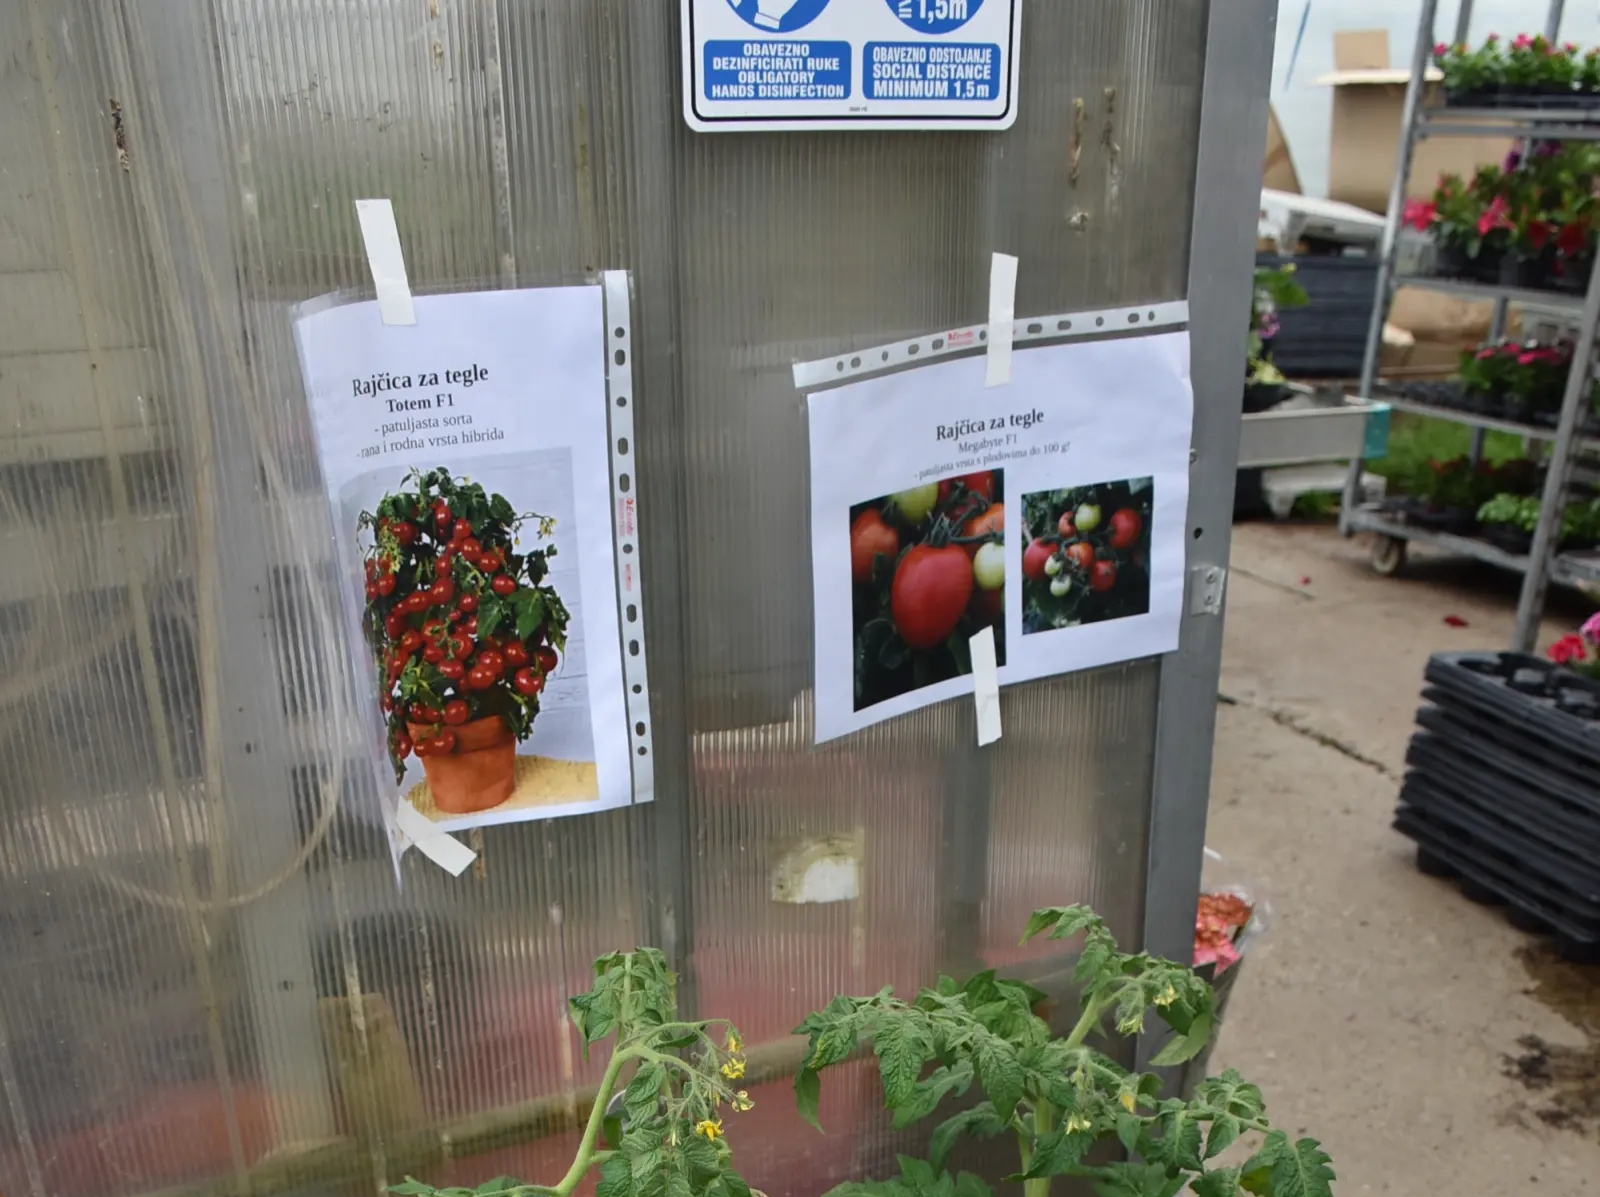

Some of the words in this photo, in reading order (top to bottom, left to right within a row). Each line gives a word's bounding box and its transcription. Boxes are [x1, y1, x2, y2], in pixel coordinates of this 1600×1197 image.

[743, 43, 810, 56] OBAVEZNO
[872, 46, 926, 63] OBAVEZNO
[929, 47, 992, 63] ODSTOJANJE
[712, 57, 803, 70] DEZINFICIRATI
[807, 57, 840, 71] RUKE
[872, 63, 922, 79] SOCIAL
[927, 64, 991, 79] DISTANCE
[738, 71, 815, 84] OBLIGATORY
[711, 85, 755, 98] HANDS
[758, 85, 844, 97] DISINFECTION
[873, 80, 949, 98] MINIMUM
[352, 372, 412, 398] Rajčica
[418, 372, 439, 387] za
[445, 364, 489, 388] tegle
[386, 398, 431, 413] Totem
[436, 393, 455, 408] F1
[381, 417, 439, 436] patuljasta
[443, 413, 473, 426] sorta
[936, 419, 985, 441] Rajčica
[989, 416, 1005, 430] za
[1010, 408, 1044, 429] tegle
[361, 444, 381, 459] rana
[390, 437, 425, 452] rodna
[428, 433, 458, 448] vrsta
[461, 427, 505, 444] hibrida
[958, 436, 1003, 454] Megabyte
